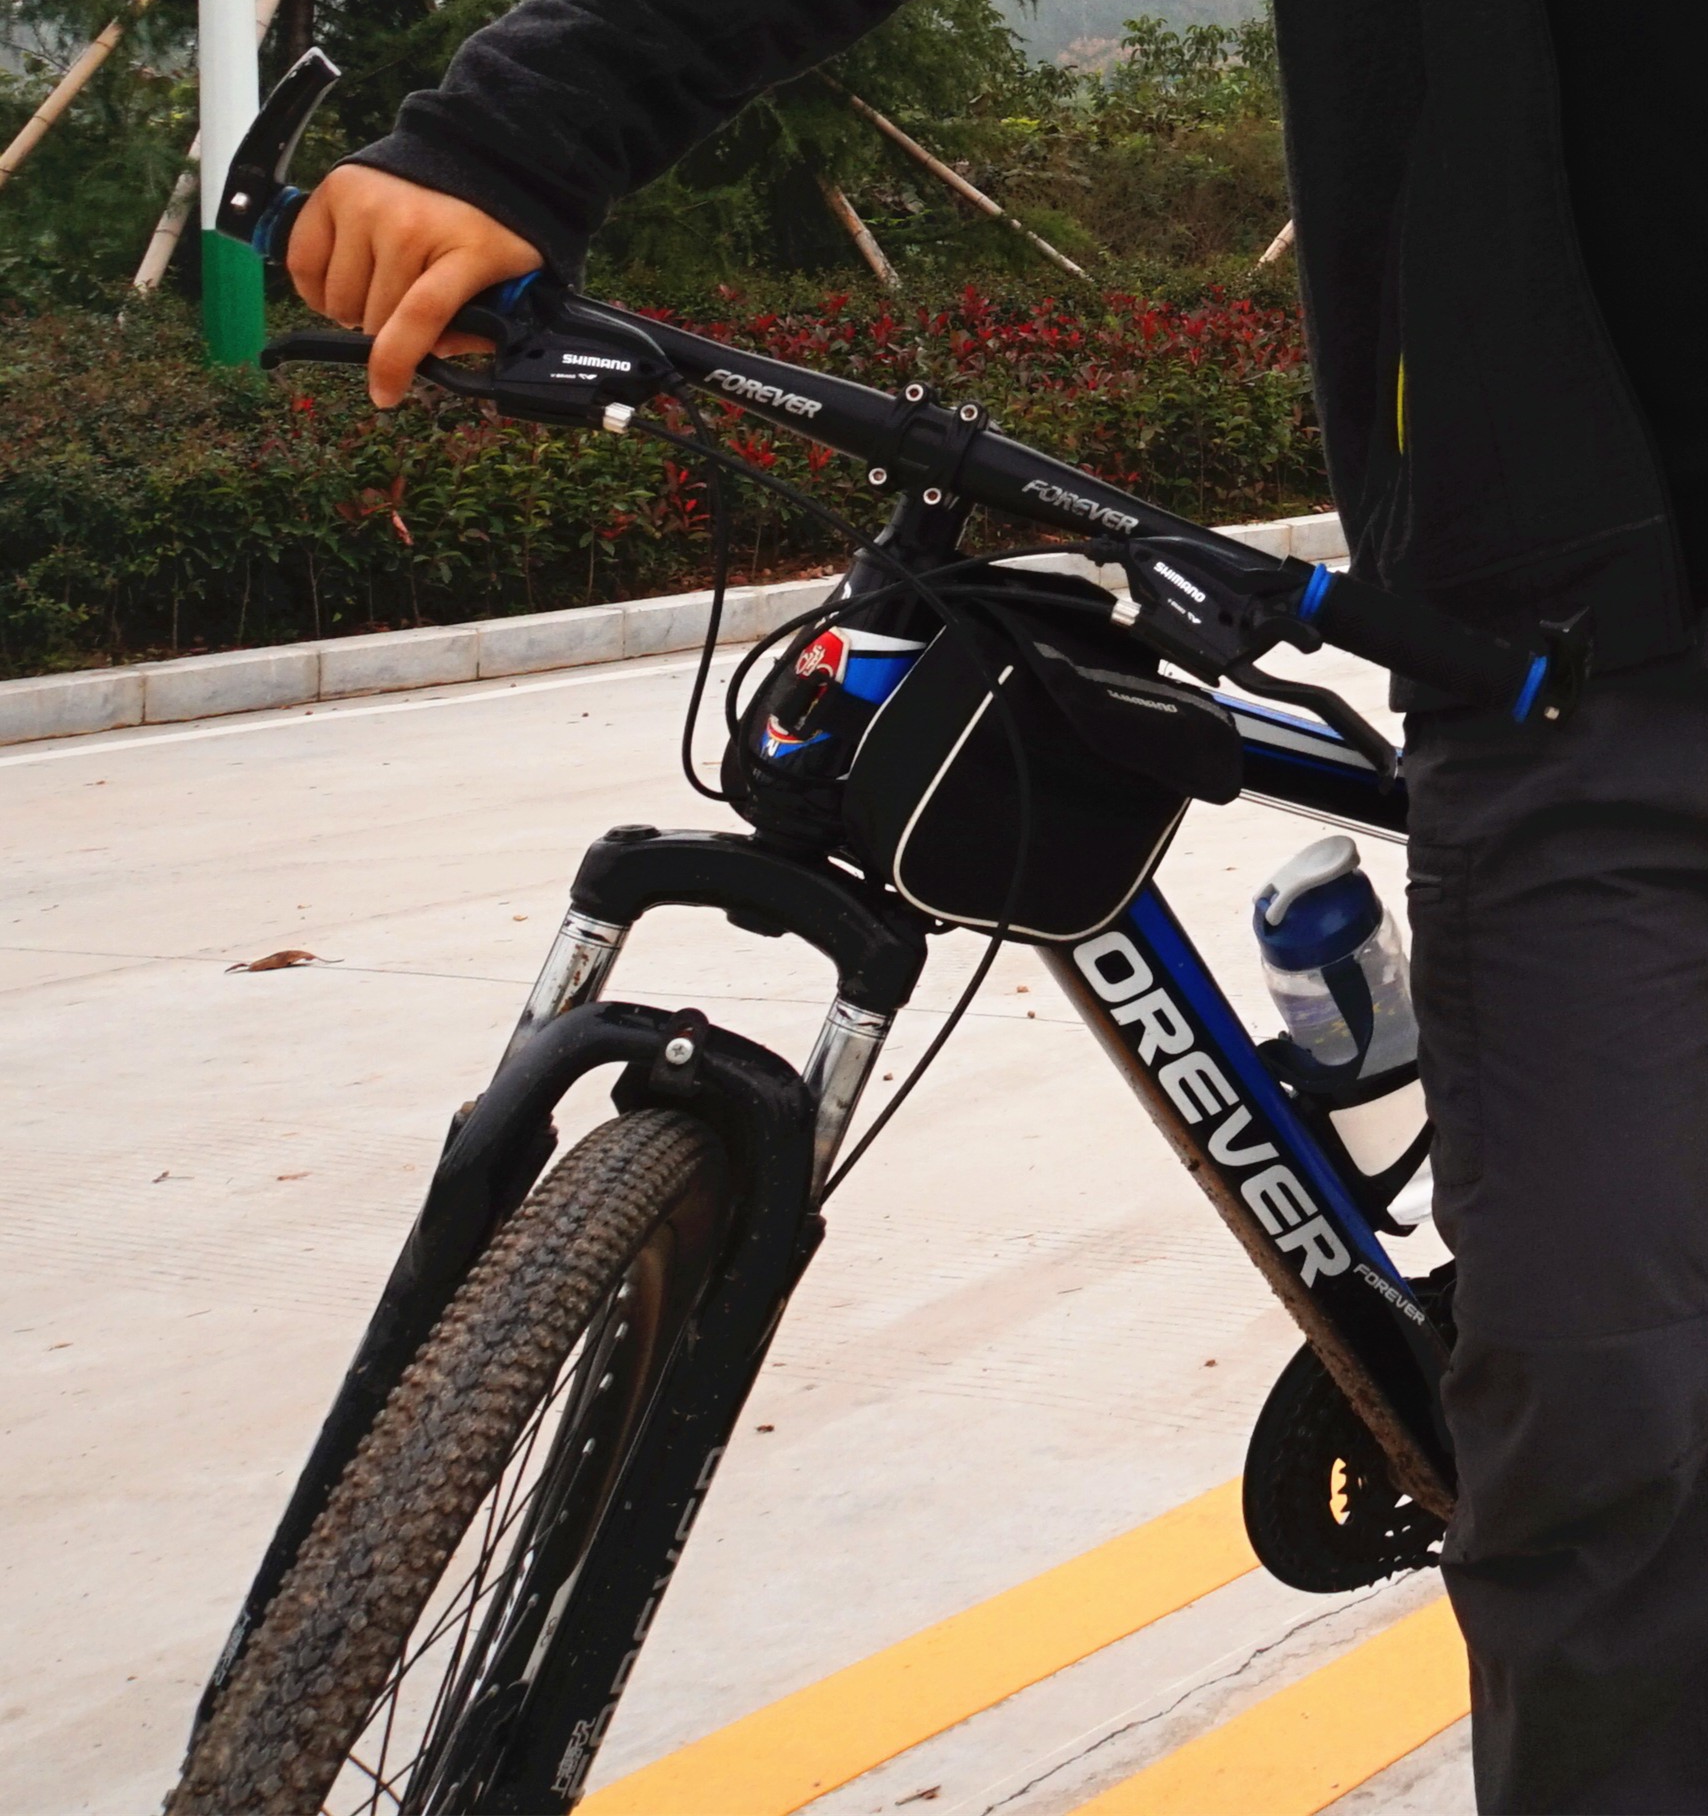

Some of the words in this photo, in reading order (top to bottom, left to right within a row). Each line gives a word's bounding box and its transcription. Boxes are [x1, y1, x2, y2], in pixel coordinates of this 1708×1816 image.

[562, 353, 632, 372] SHIMANO
[703, 368, 823, 419] FOREVER
[1021, 479, 1140, 535] FOREVER
[1153, 561, 1206, 602] SHIMANO
[1072, 930, 1352, 1288] OREVER
[1353, 1263, 1426, 1326] FOREVER
